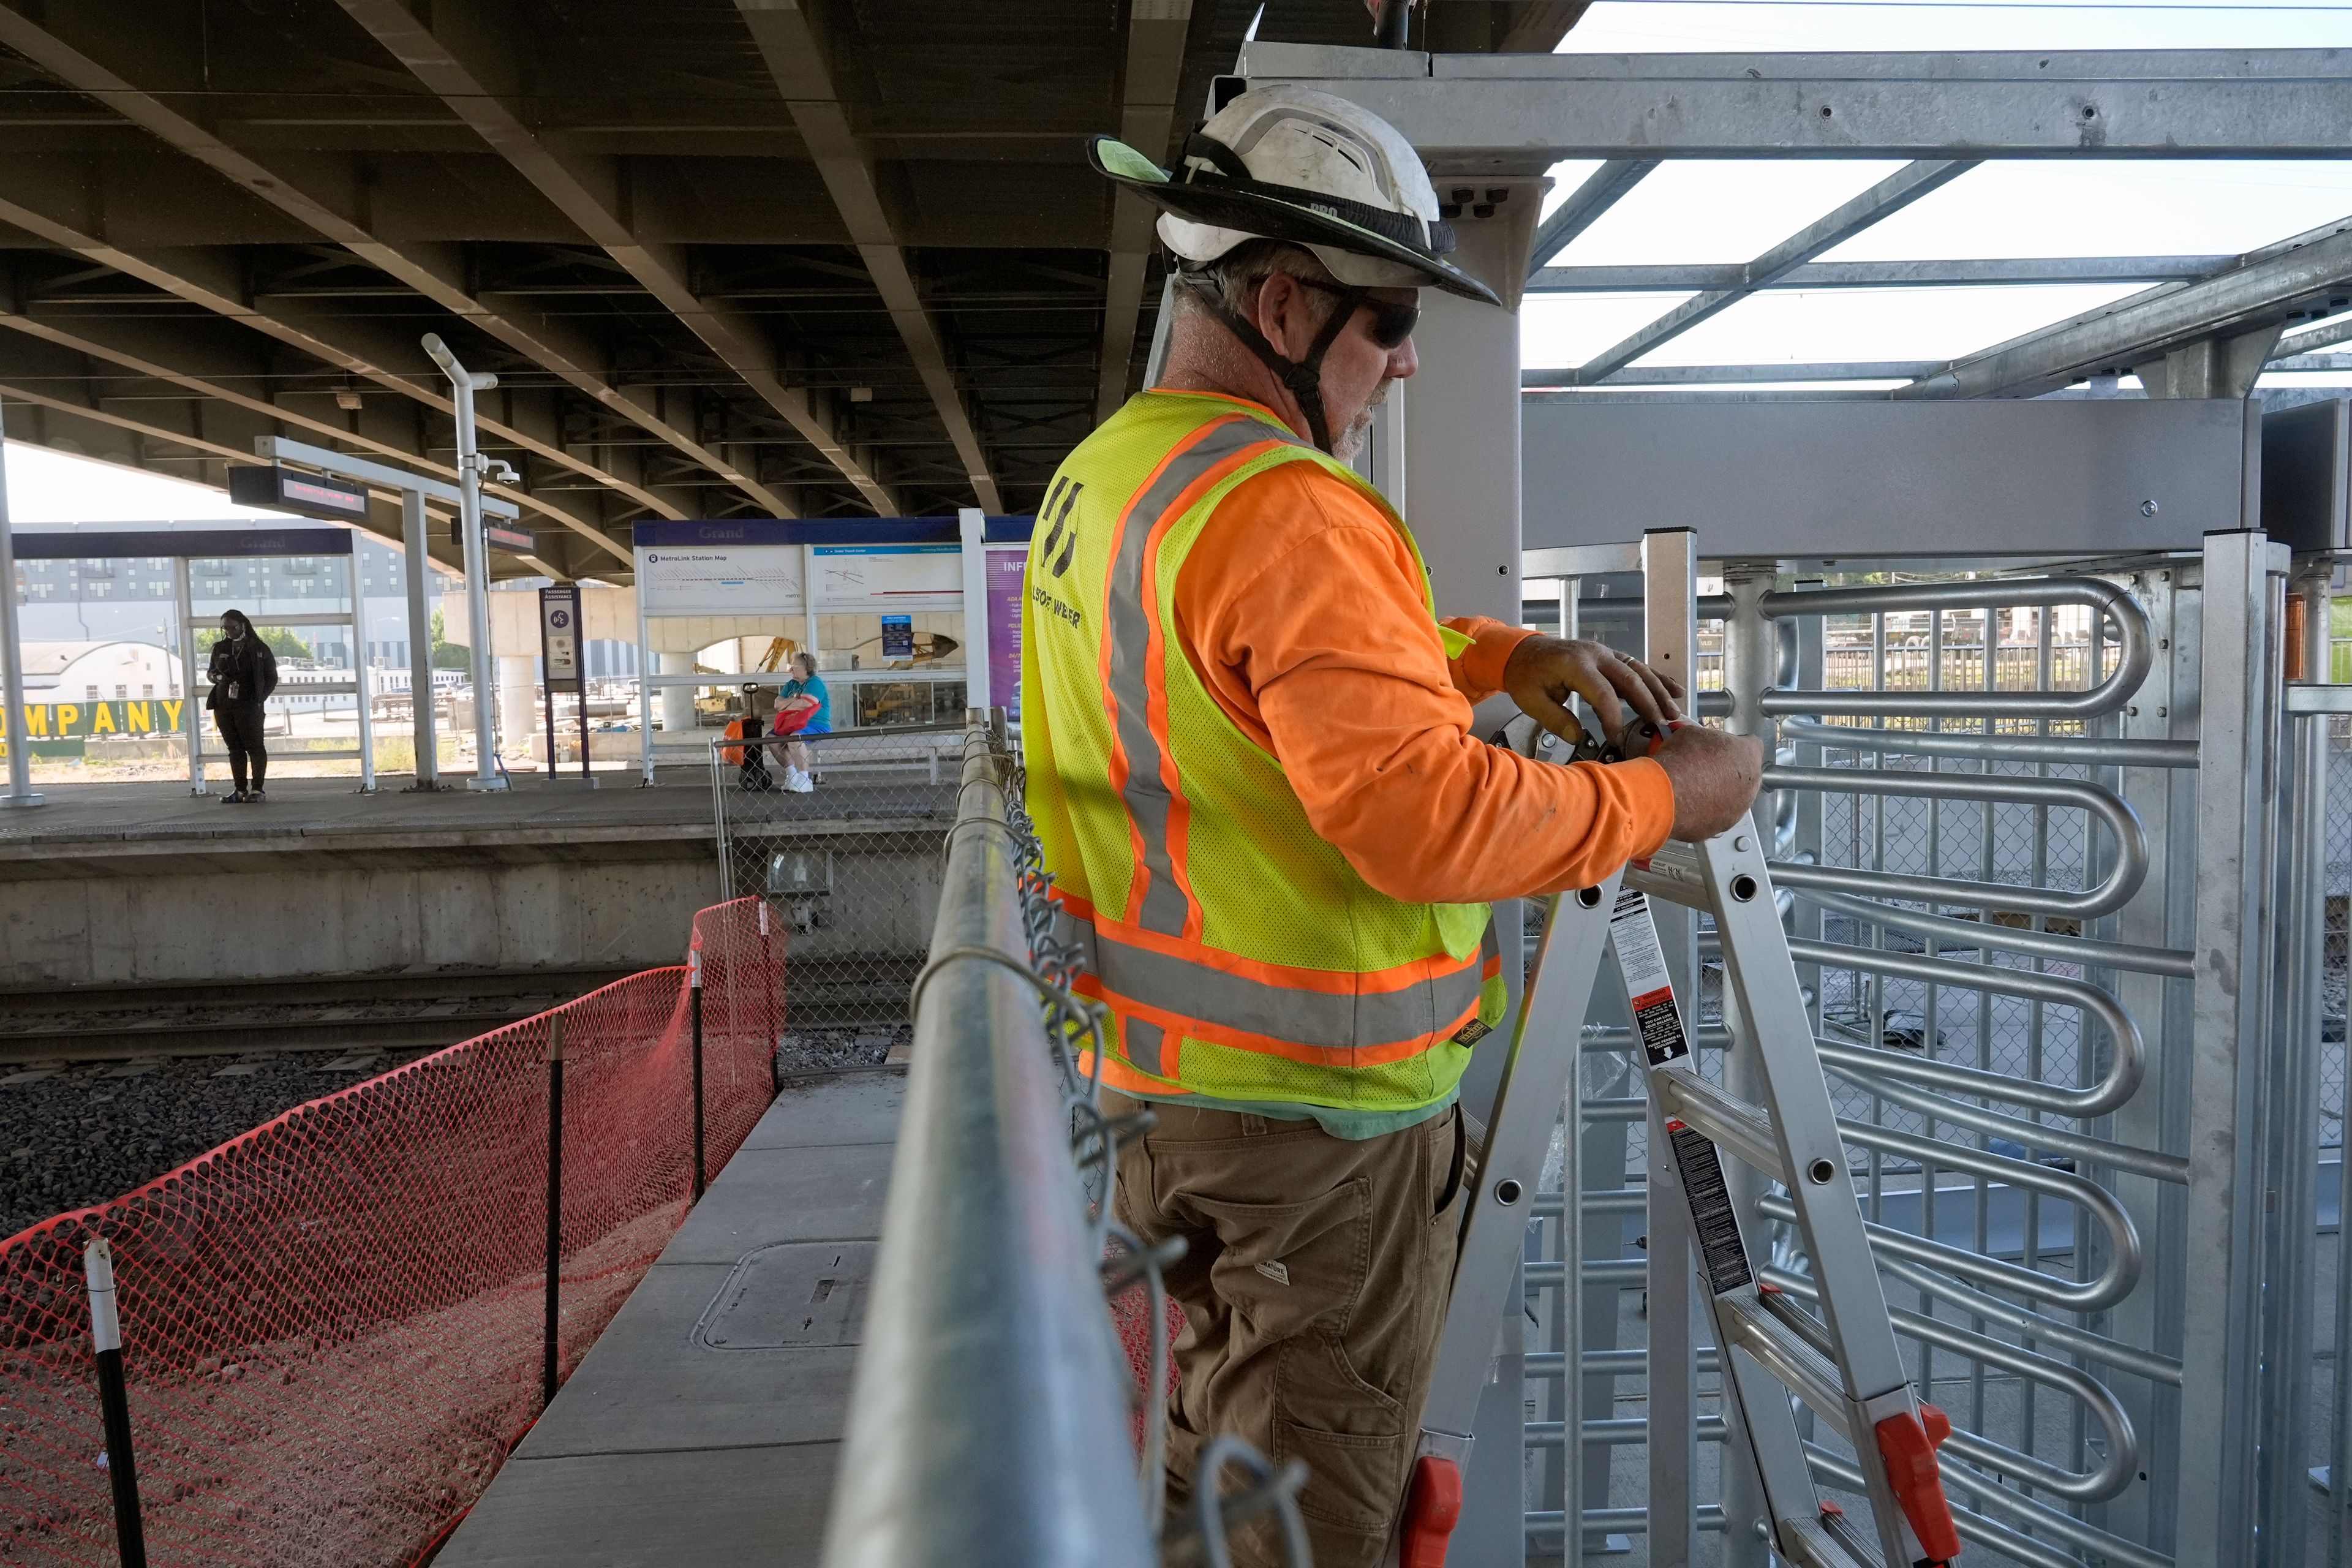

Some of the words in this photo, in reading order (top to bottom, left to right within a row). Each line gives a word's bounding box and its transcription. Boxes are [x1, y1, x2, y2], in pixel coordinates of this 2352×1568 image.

[699, 526, 745, 539] Grand
[241, 535, 285, 548] Grand
[1641, 994, 1672, 1008] ADVERTENCIA
[1643, 989, 1666, 1000] WARNING
